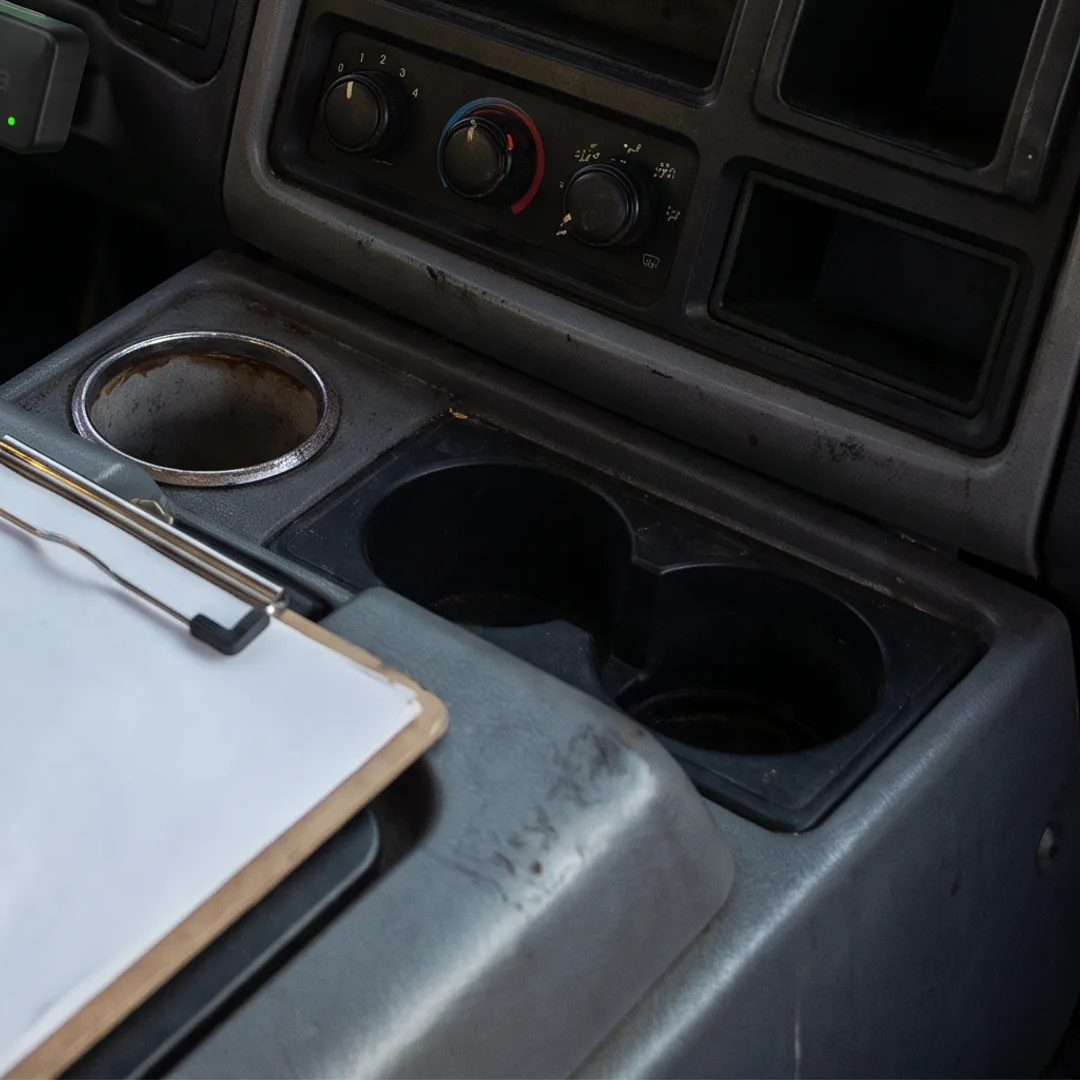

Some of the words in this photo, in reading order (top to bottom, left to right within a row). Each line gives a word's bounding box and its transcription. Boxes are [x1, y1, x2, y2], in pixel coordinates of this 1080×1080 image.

[379, 54, 387, 65] 2
[399, 67, 406, 78] 3
[411, 88, 419, 98] 4
